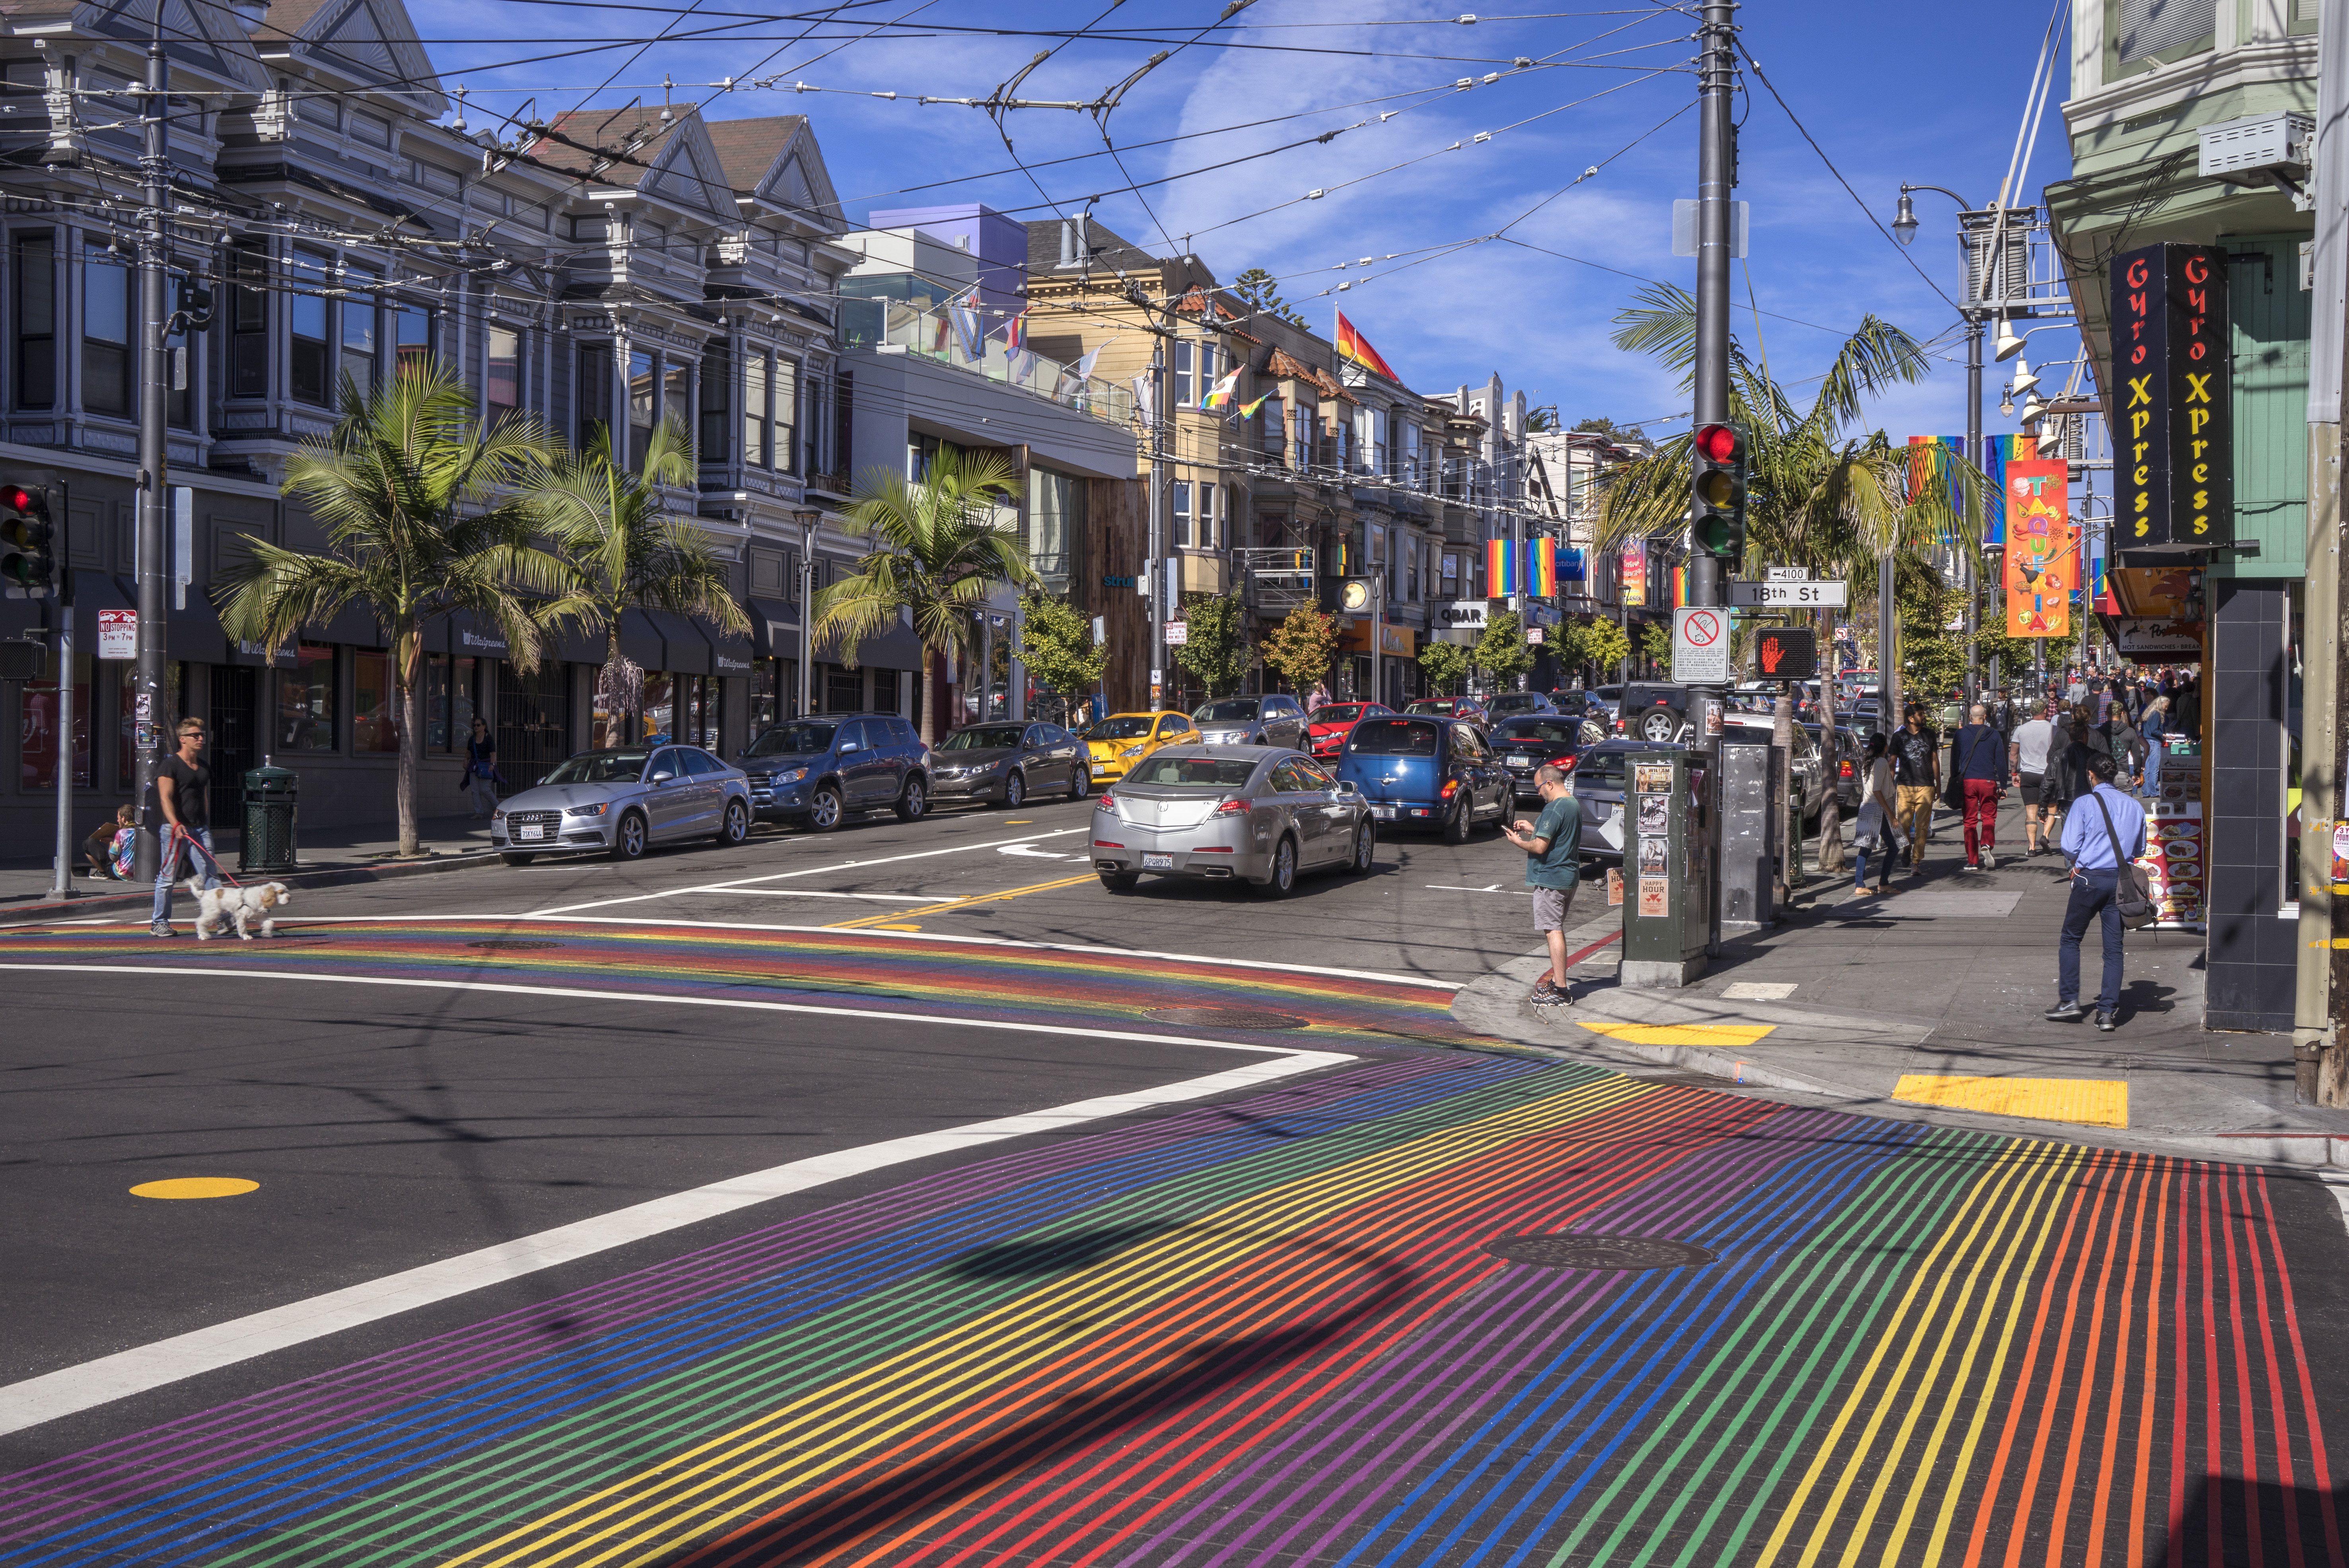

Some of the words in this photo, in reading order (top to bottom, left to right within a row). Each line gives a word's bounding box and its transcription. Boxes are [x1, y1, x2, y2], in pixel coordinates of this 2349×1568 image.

[2127, 258, 2148, 364] Gyro
[2184, 255, 2208, 360] Gyro
[2127, 373, 2152, 537] Xpress
[2185, 372, 2211, 535] Xpress
[2028, 476, 2049, 632] TAQUERIA
[1104, 574, 1135, 587] strut
[1781, 570, 1803, 578] 4100
[1752, 588, 1786, 601] 18th
[1799, 588, 1819, 601] St
[1441, 609, 1481, 625] QBAR
[101, 623, 109, 632] NO
[471, 635, 506, 650] Walgreens
[724, 658, 750, 671] Walgreens
[1145, 858, 1171, 866] 6PQR975
